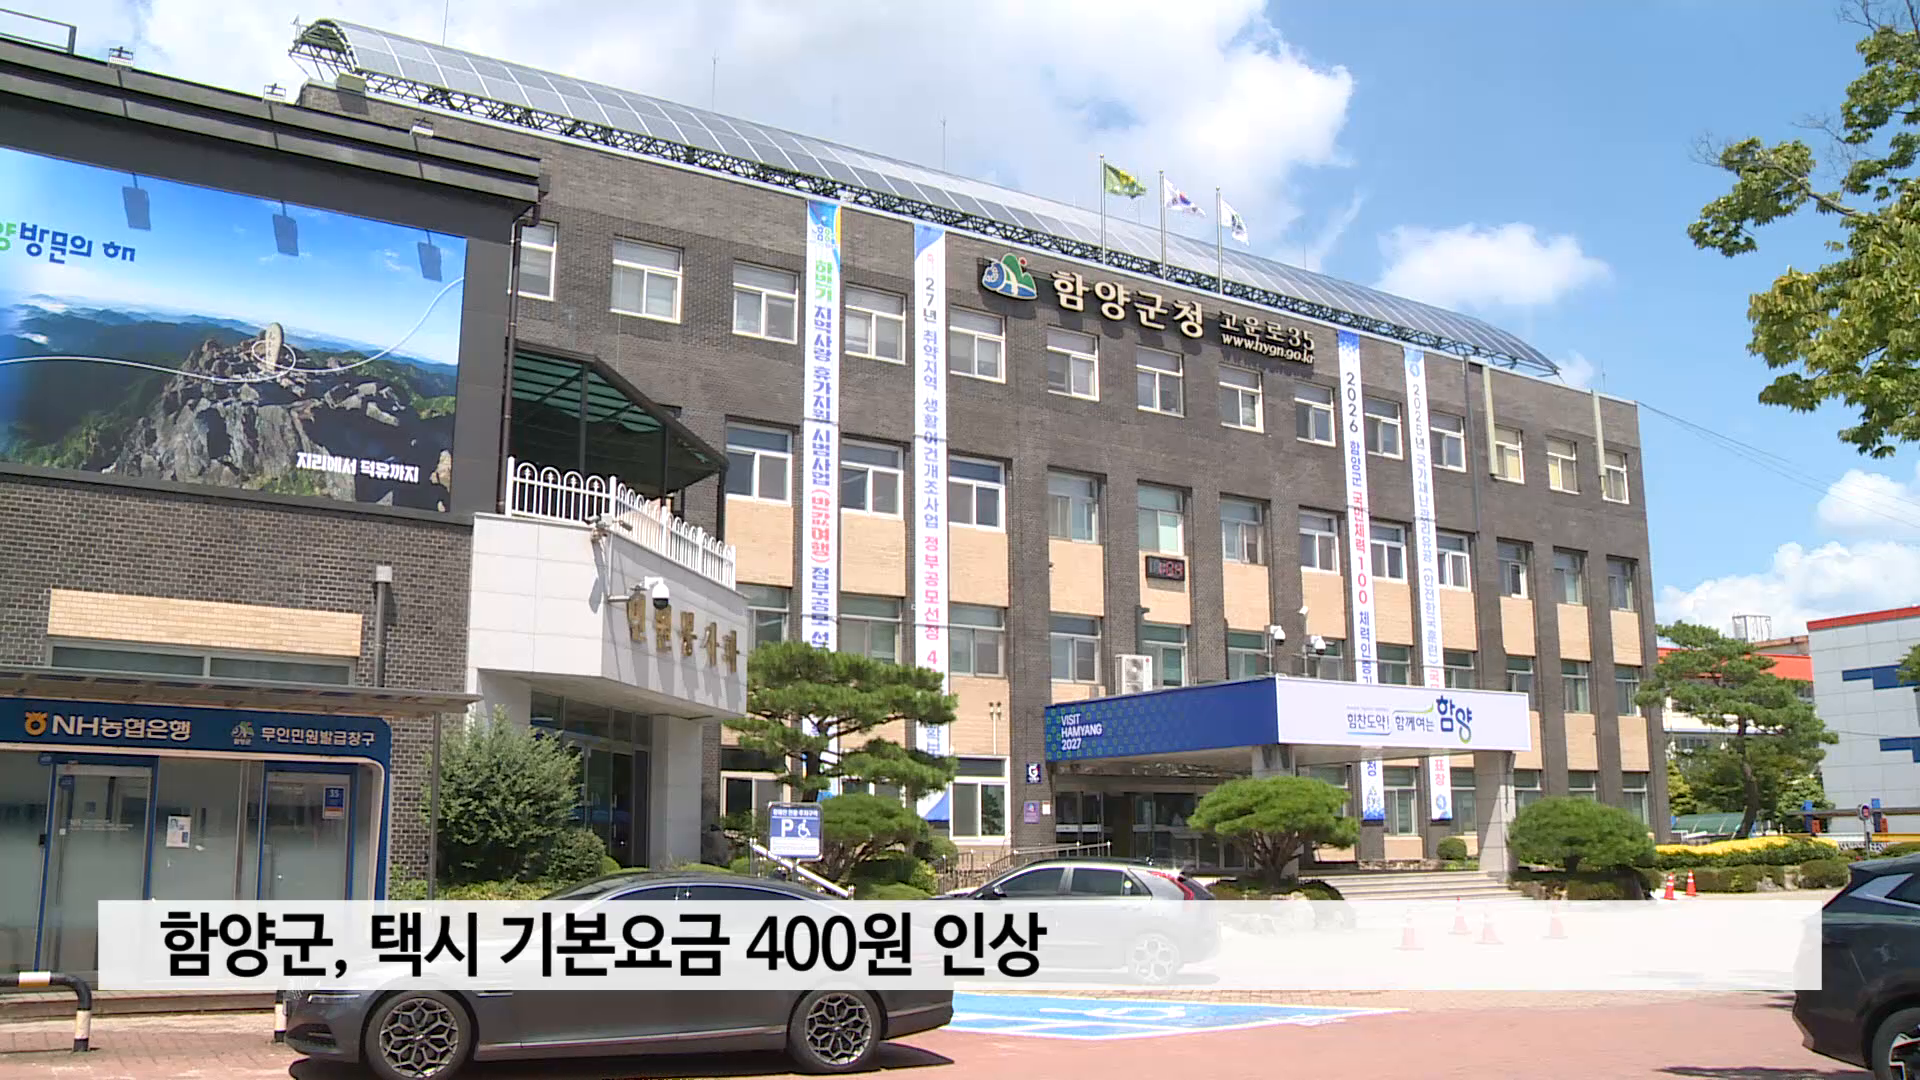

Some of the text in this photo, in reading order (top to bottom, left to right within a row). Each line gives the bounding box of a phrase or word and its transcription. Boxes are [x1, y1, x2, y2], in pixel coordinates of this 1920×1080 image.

[102, 241, 136, 262] 해
[816, 260, 832, 303] 하반기
[1051, 270, 1204, 339] 함양군청
[814, 305, 832, 362] 지역사랑
[1221, 332, 1315, 364] www.hygn.go.kr
[923, 329, 938, 391] 취약지역
[813, 366, 831, 422] 휴가지원
[1346, 372, 1359, 433] 2026
[296, 451, 420, 483] 지리에서 덕유까지
[812, 428, 831, 487] 시범사업
[924, 397, 939, 530] 생활여건개조사업
[1350, 440, 1362, 488] 함양군
[811, 489, 831, 563] (반값여행)
[811, 566, 830, 626] 정부공모
[1359, 611, 1373, 685] 체력인증기
[52, 715, 191, 741] NH농협은행
[261, 727, 375, 746] 무인민원발급창구
[1061, 713, 1081, 726] VISIT
[1061, 723, 1103, 738] HAMYANG
[1347, 695, 1472, 744] 힘찬도약! 함께여는 함양
[1061, 738, 1082, 751] 2027
[781, 819, 794, 837] P
